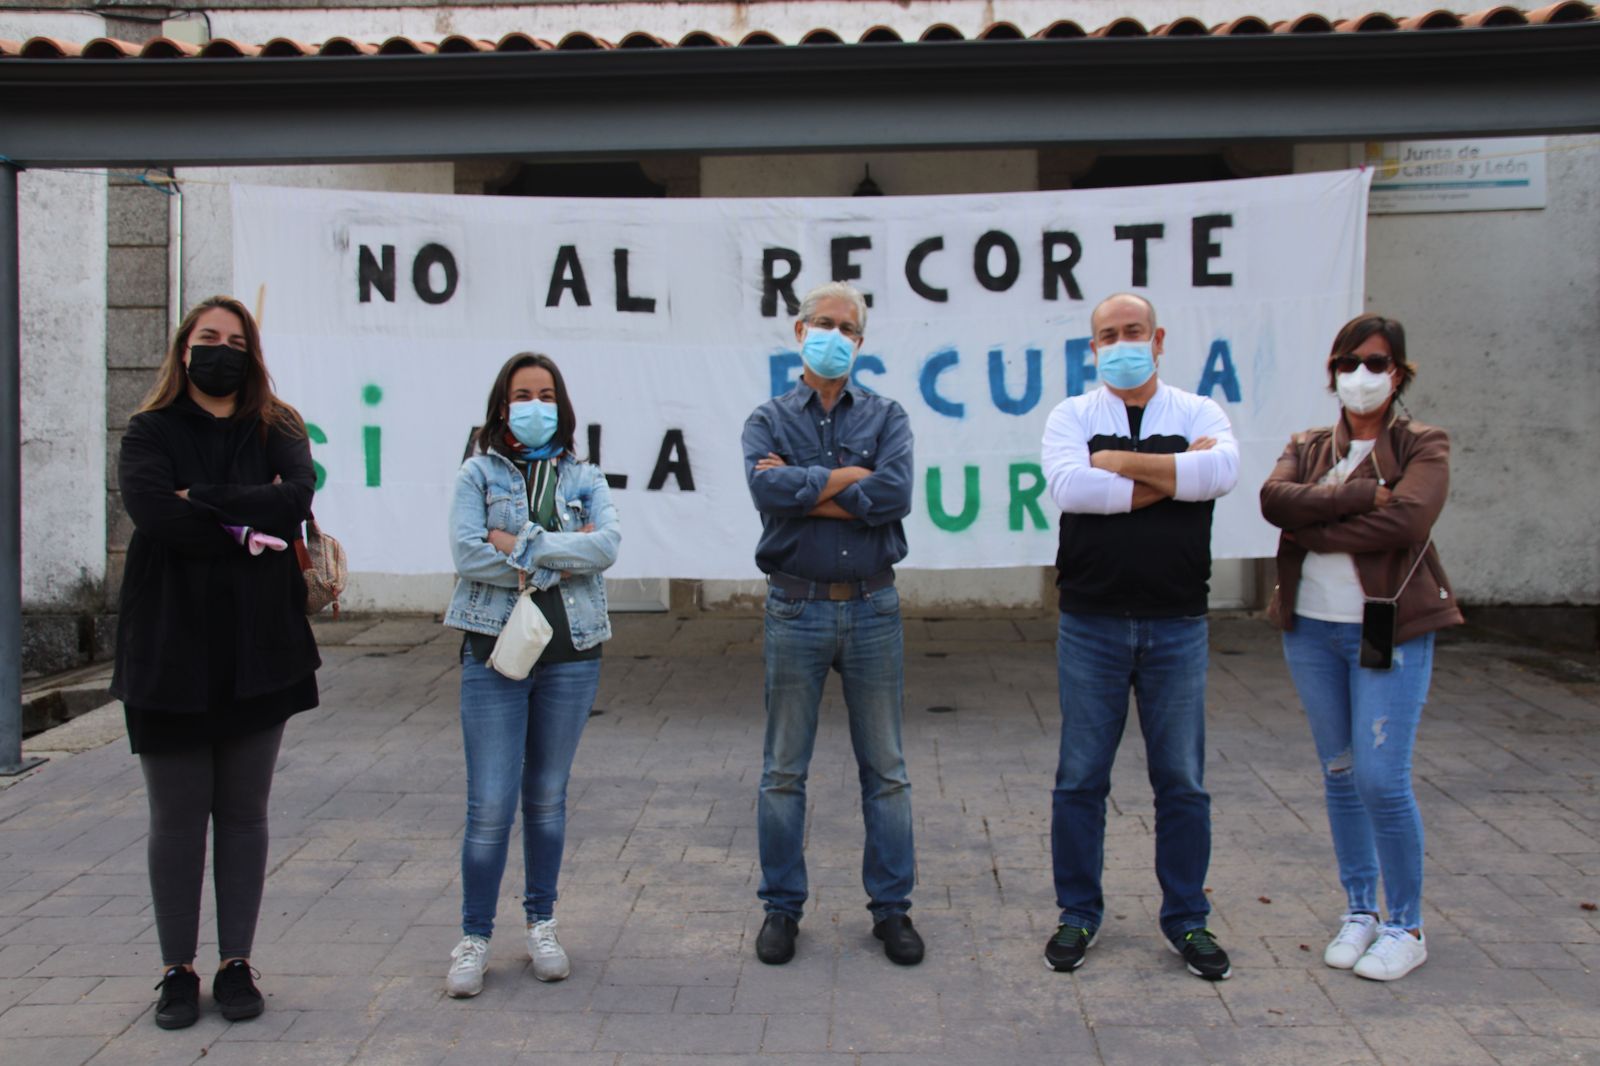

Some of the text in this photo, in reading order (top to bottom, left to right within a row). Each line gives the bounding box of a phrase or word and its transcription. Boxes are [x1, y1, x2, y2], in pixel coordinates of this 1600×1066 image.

[1402, 158, 1528, 179] Castilla y León
[1403, 145, 1481, 161] Junta de
[358, 213, 1234, 318] NO AL RECORTE
[587, 423, 696, 492] LA
